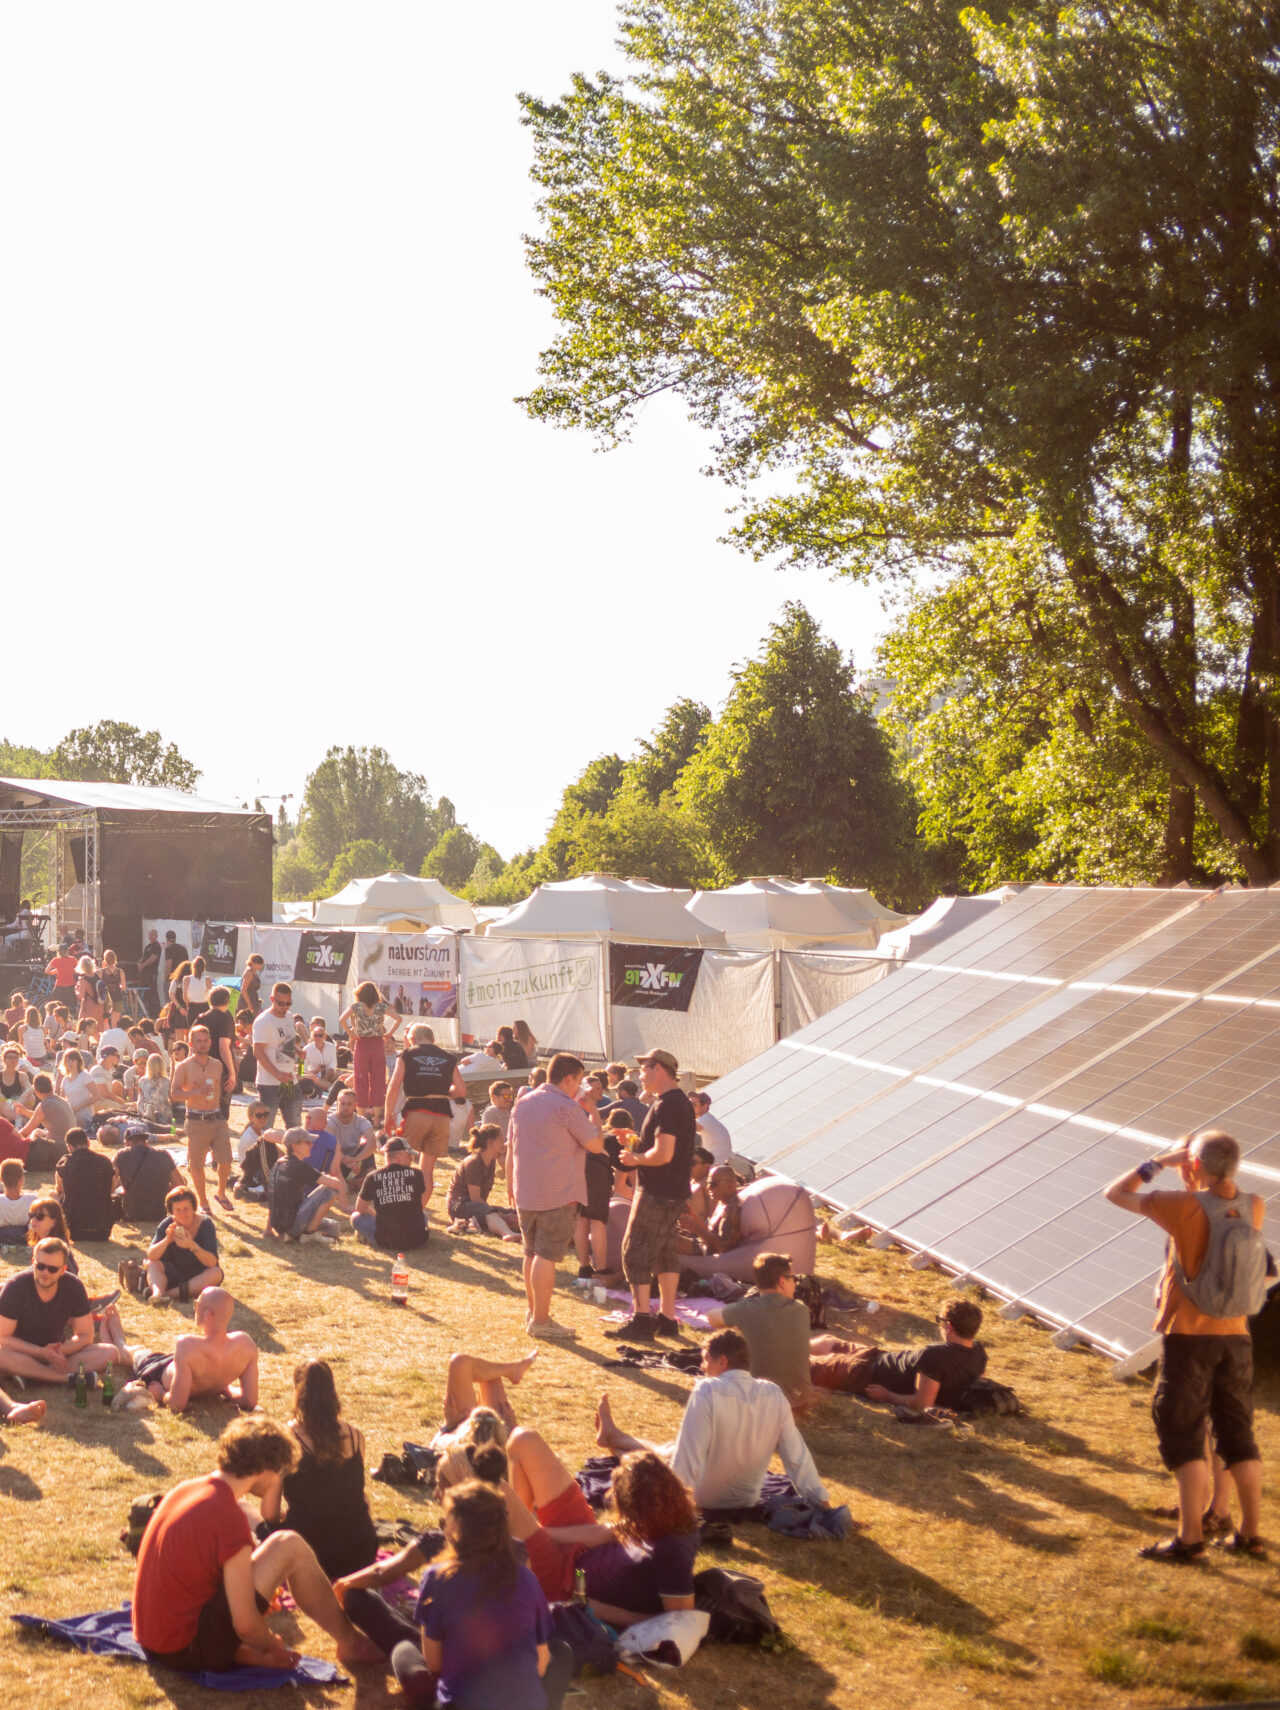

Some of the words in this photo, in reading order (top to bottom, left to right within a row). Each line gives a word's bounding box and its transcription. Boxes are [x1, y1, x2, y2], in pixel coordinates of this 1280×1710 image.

[468, 966, 574, 1005] #moinzukunft
[373, 1169, 415, 1182] TRADITION
[382, 1178, 405, 1188] EHRE
[376, 1185, 414, 1198] DISZIPLIN
[379, 1193, 412, 1205] LEISTUNG
